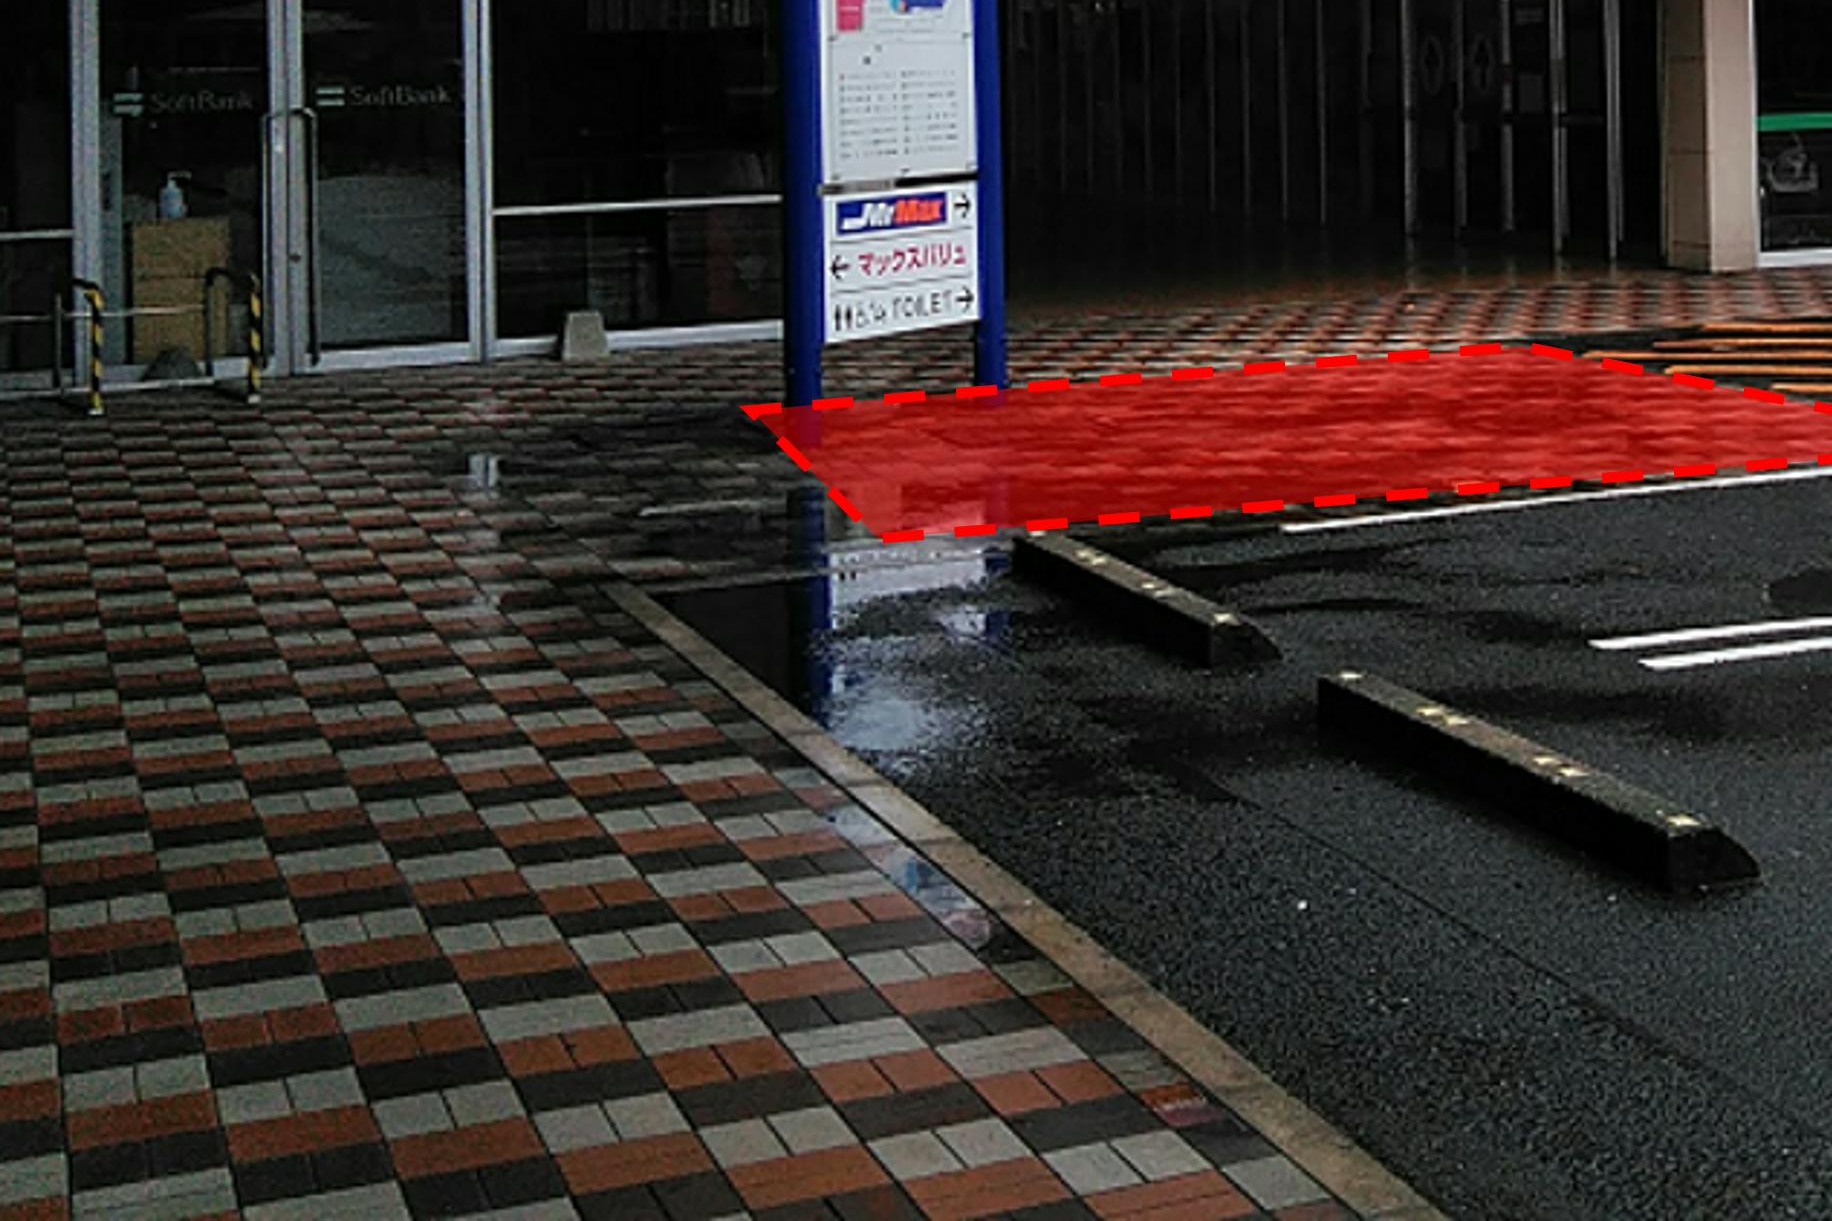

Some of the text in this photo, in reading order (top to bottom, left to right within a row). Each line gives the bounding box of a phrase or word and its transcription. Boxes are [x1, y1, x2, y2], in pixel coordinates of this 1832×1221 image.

[149, 89, 253, 113] SoftBank
[349, 83, 451, 107] SoftBank
[841, 198, 944, 230] MrMax
[858, 242, 967, 276] マックスバリュ
[892, 290, 952, 319] TOILET
